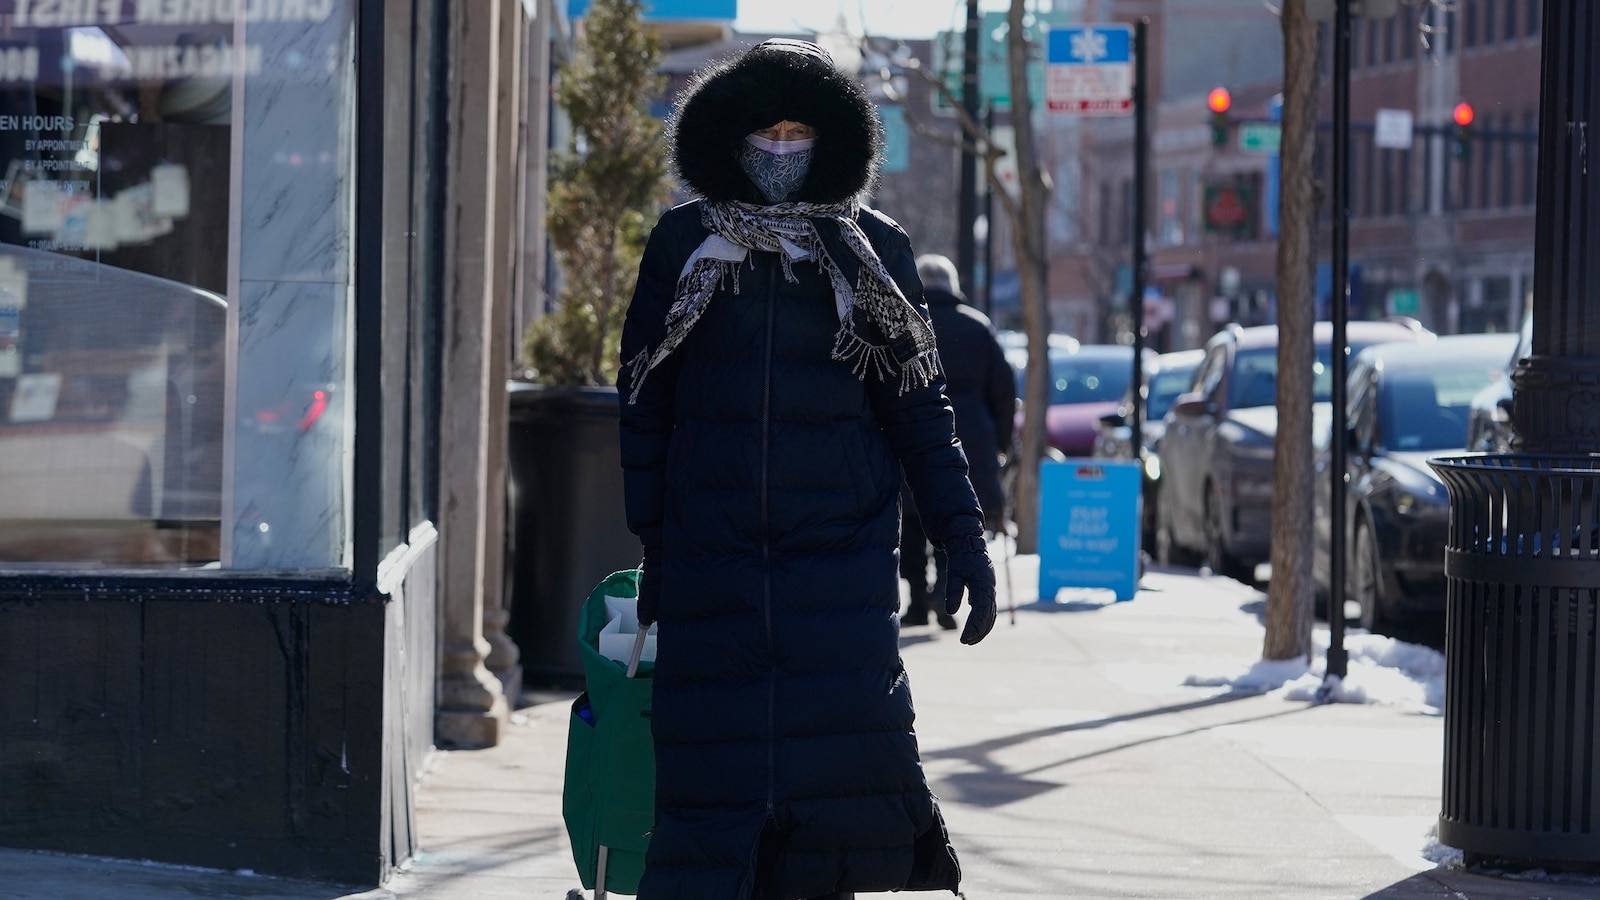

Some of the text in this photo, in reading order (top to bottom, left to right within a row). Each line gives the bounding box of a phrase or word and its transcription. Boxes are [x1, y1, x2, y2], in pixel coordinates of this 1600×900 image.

[0, 115, 75, 131] EN HOURS
[25, 139, 89, 151] BY APPOINTMENT
[25, 160, 36, 170] BY
